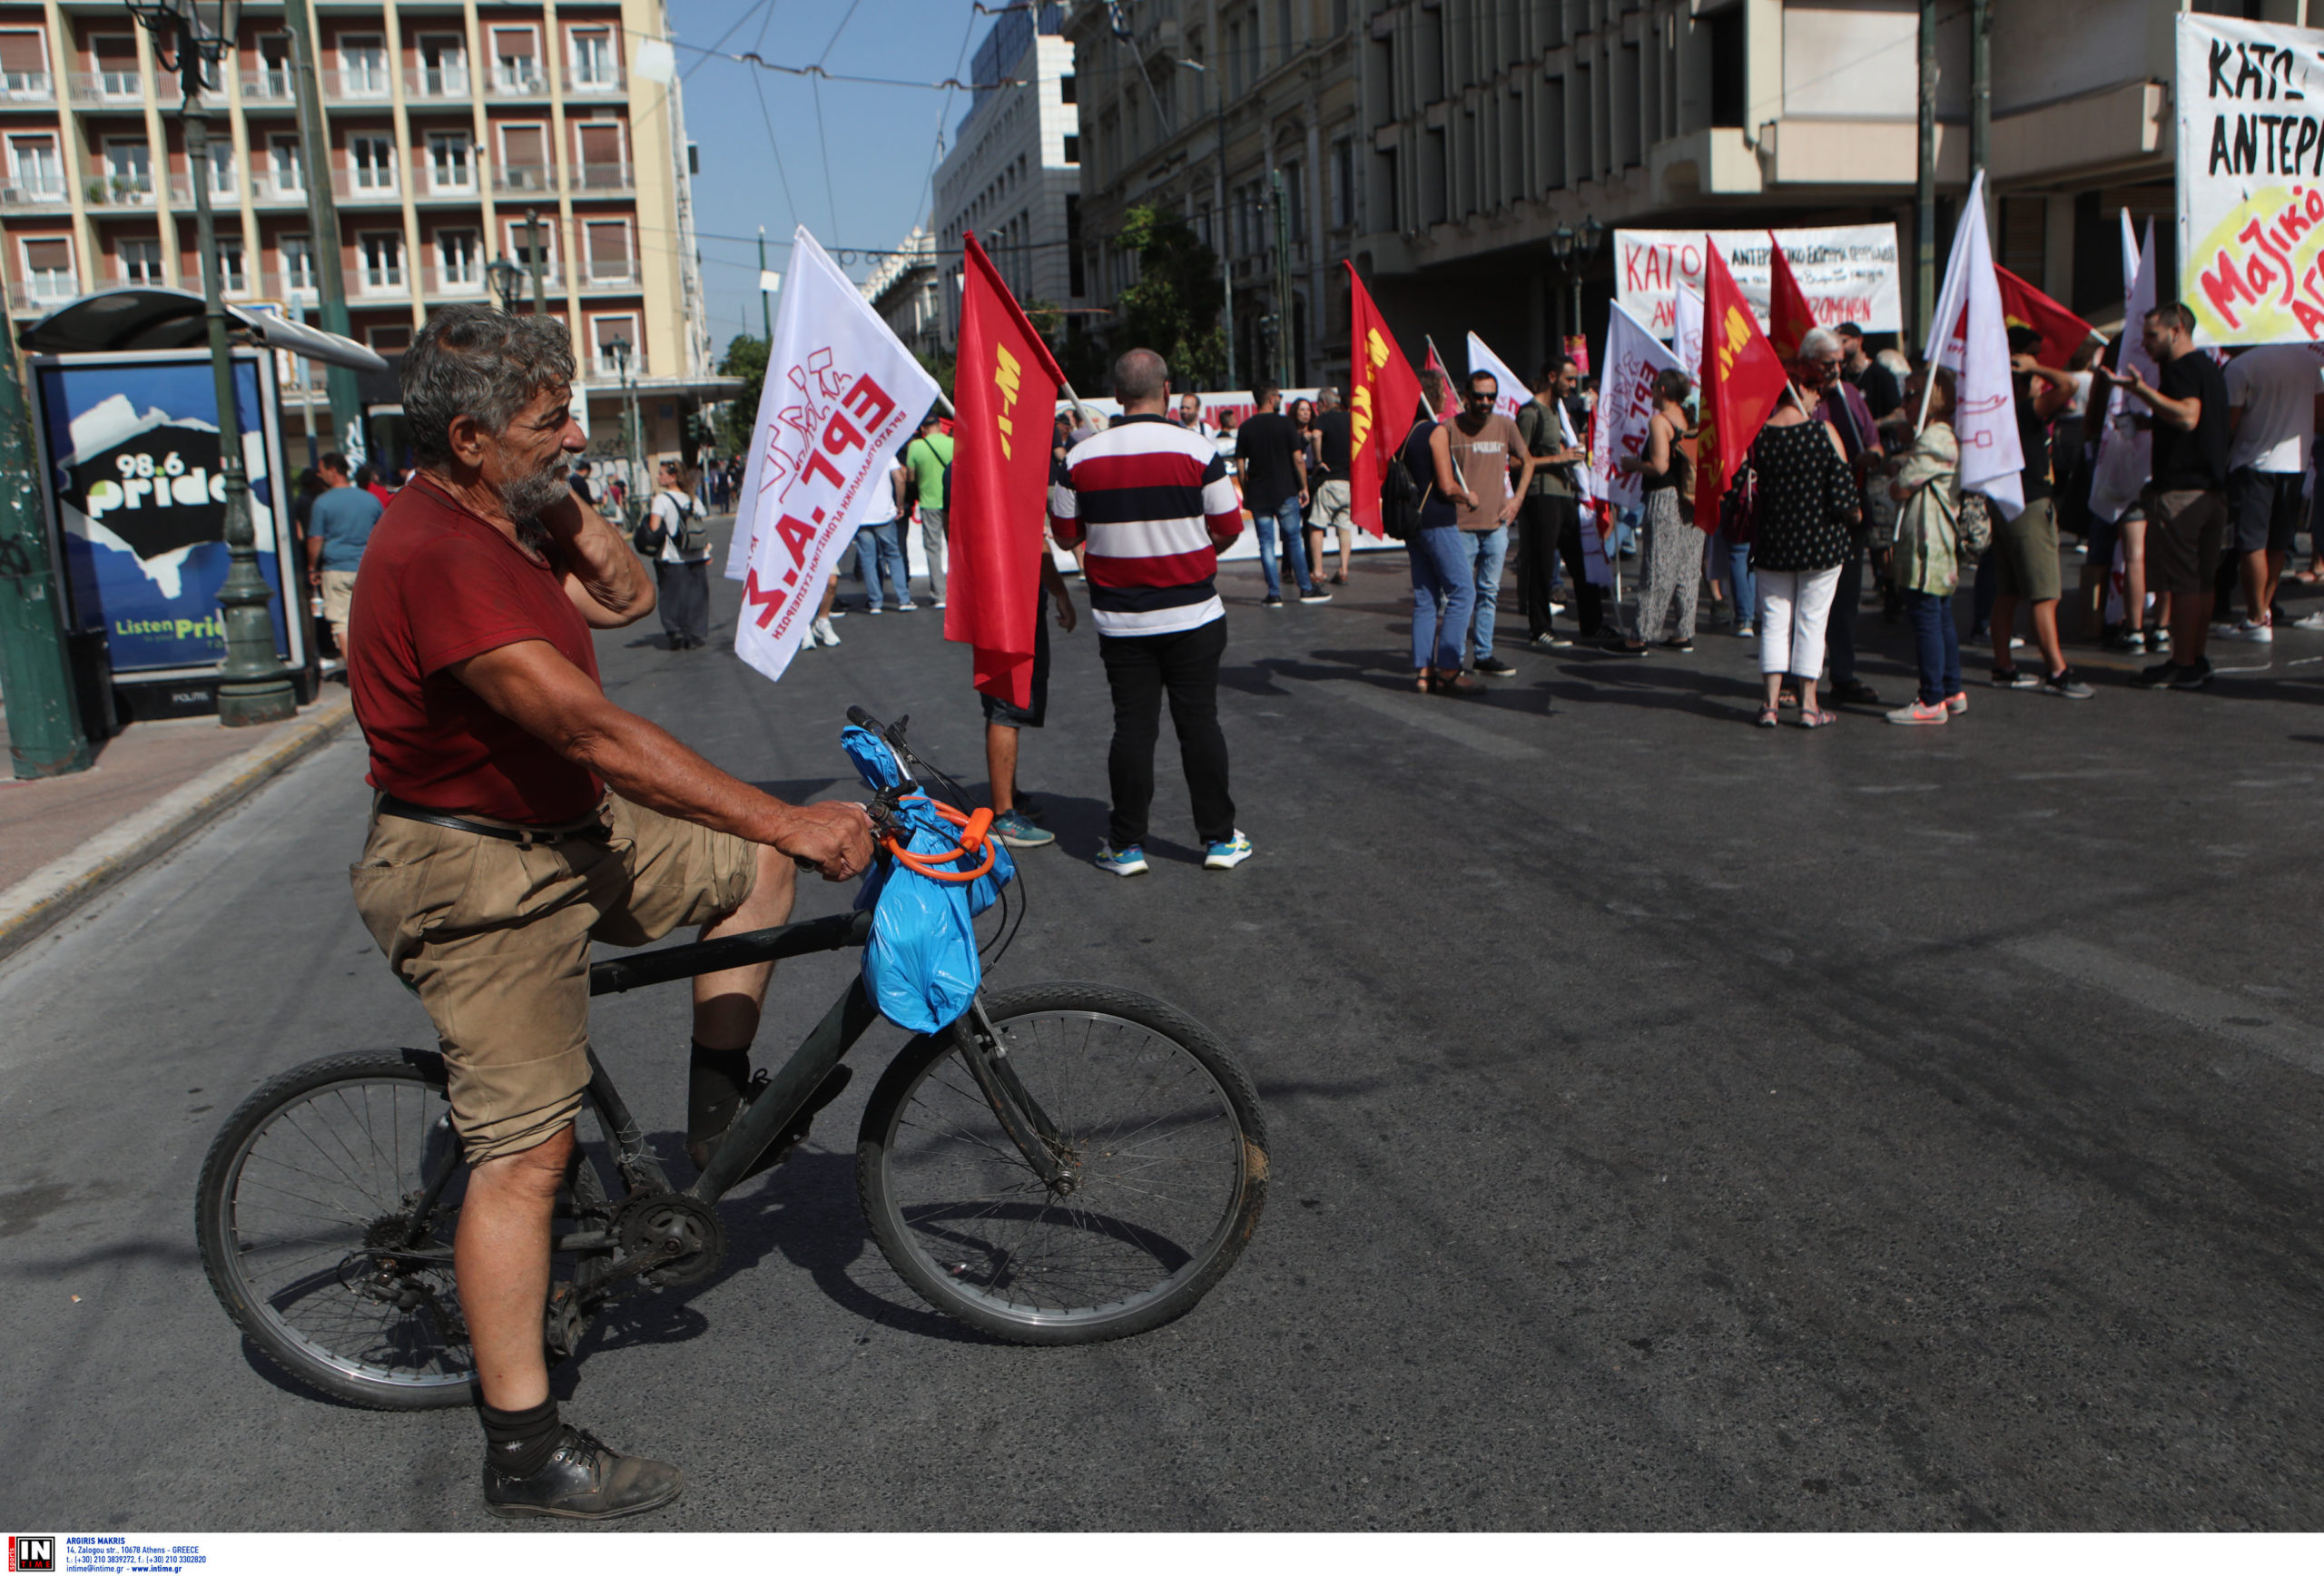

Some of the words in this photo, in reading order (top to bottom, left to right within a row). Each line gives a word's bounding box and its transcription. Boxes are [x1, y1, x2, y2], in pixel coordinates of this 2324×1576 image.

[2208, 113, 2324, 176] ΑΝΤΕΡ
[115, 451, 185, 479] 98.6
[115, 619, 174, 635] Listen
